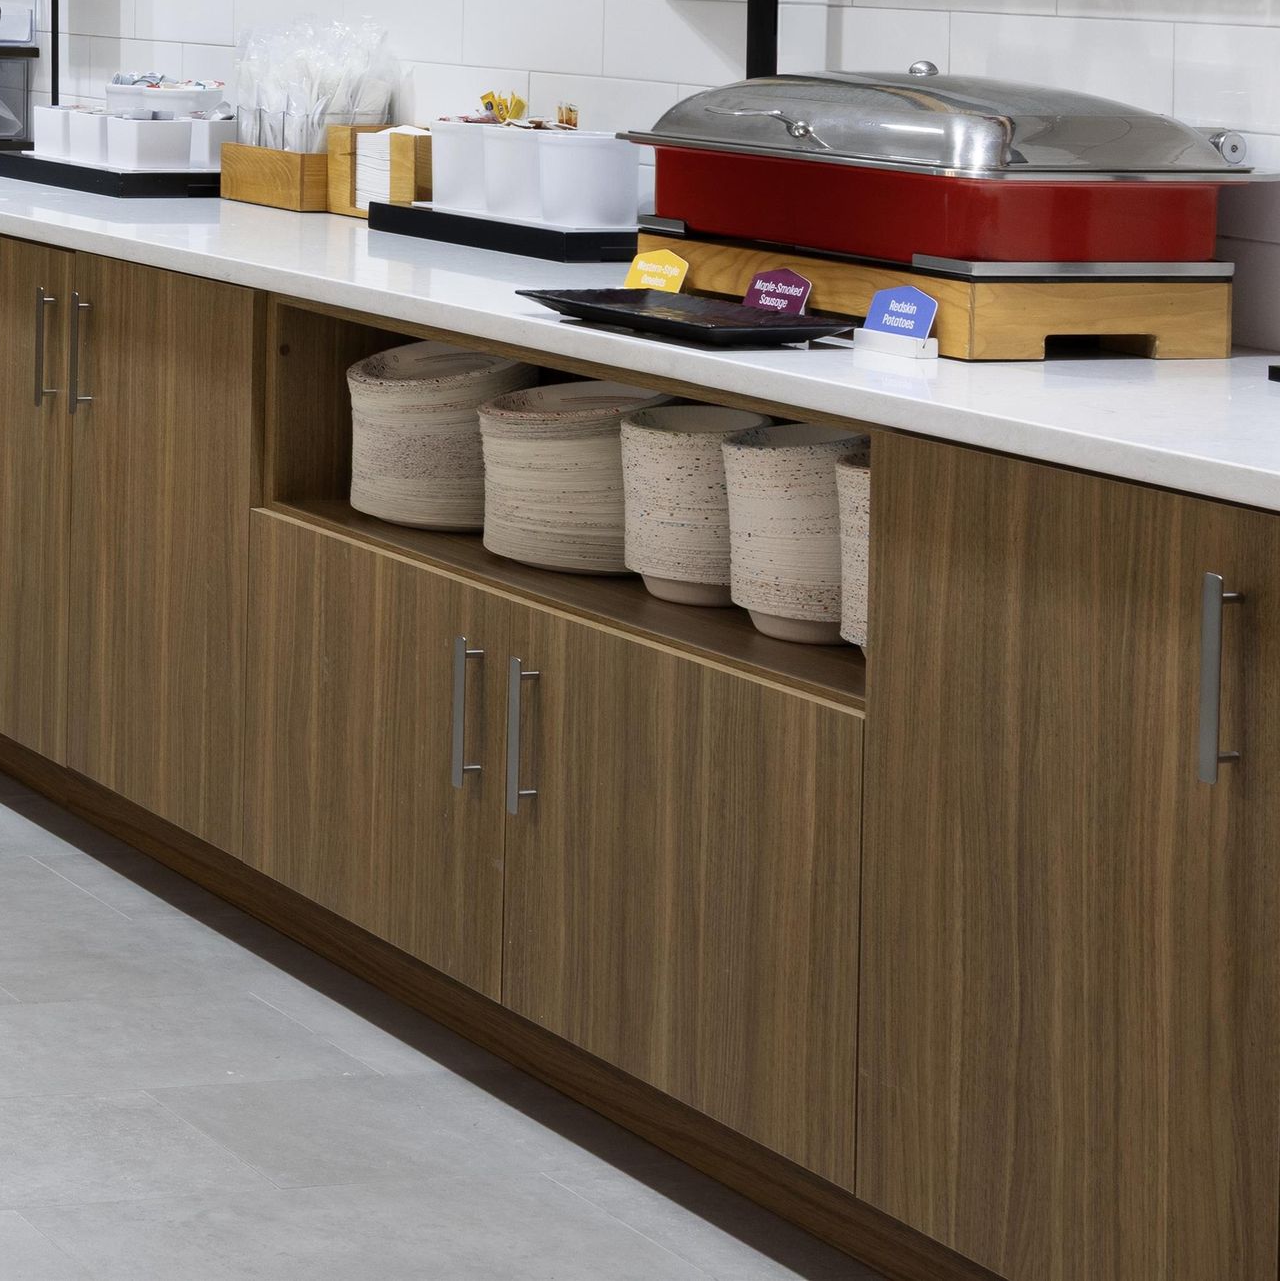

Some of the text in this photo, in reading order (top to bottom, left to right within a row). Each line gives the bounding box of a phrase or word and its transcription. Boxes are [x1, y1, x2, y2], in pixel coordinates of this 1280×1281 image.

[754, 279, 804, 297] Maple-Smoked
[758, 294, 788, 310] Sausage
[888, 299, 917, 315] Redskin
[881, 313, 916, 330] Potatoes
